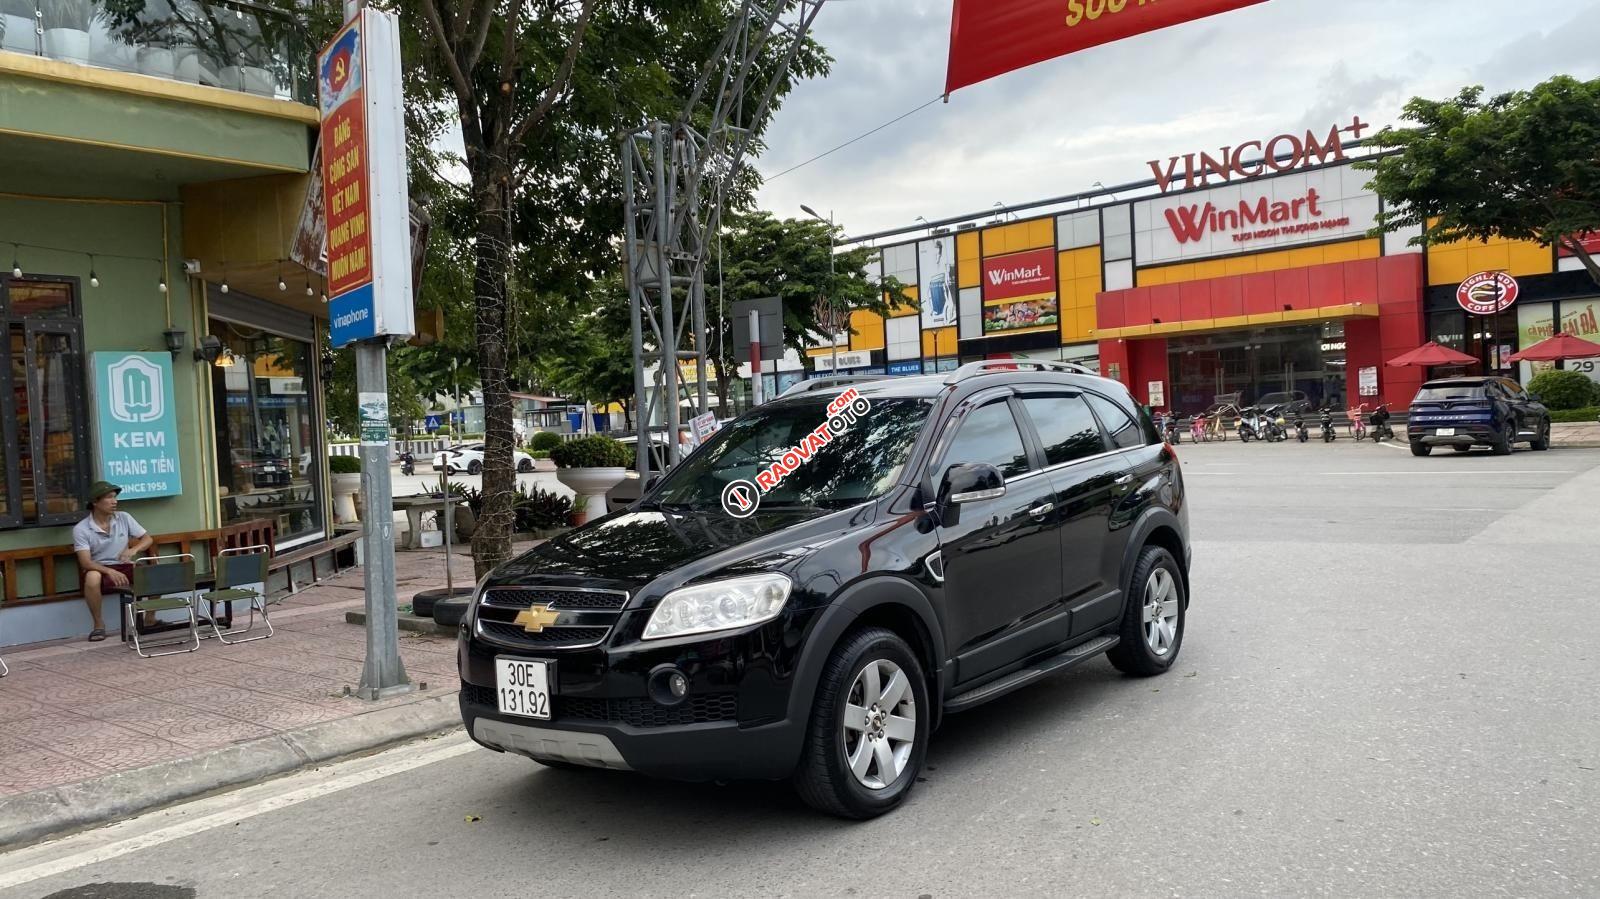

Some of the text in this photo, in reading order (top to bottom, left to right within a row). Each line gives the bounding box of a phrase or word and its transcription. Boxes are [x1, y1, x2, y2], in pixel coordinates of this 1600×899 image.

[1164, 187, 1322, 244] WinMart
[988, 265, 1042, 286] WinMart
[334, 308, 369, 329] vinaphone
[1572, 361, 1595, 373] 29
[114, 431, 165, 448] KEM
[108, 454, 147, 476] TRÀNG
[119, 483, 146, 494] SINCE
[508, 663, 535, 688] 30E
[501, 687, 548, 716] 131.92
